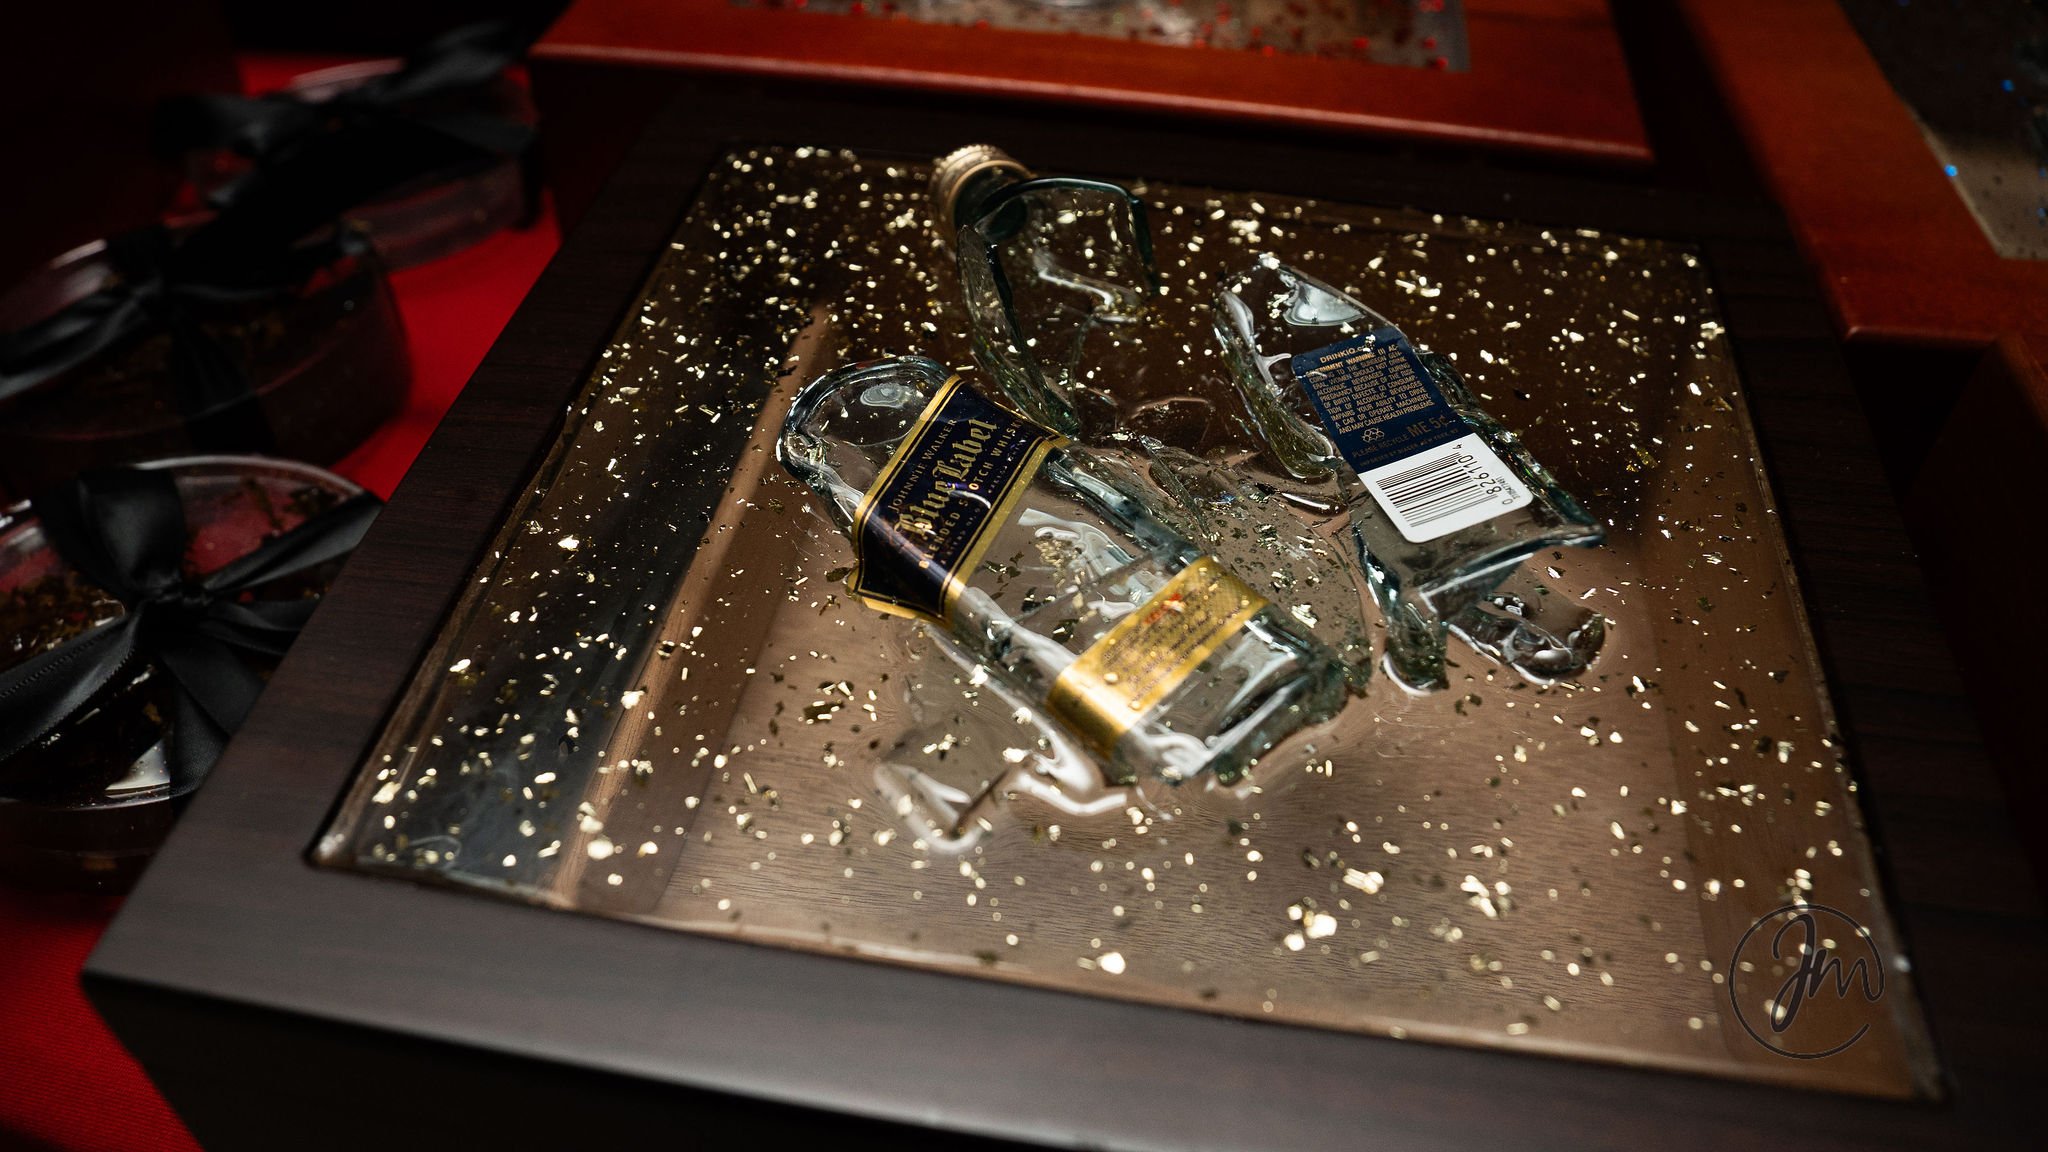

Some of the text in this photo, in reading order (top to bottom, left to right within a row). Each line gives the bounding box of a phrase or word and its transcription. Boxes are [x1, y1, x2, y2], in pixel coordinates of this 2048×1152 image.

[1305, 361, 1344, 377] GERNMENT
[1309, 372, 1335, 383] CORDNG
[1360, 356, 1387, 367] SURGEON
[1320, 343, 1371, 363] DRINKIQ.c
[1329, 374, 1351, 384] WOMEN
[1352, 366, 1375, 376] SHOULD
[1388, 356, 1406, 365] DRINK
[1316, 362, 1410, 396] ALCOHOLIC BEVERAGES DURING
[1320, 388, 1353, 402] PREGNANCY
[1354, 379, 1379, 391] BECAUSE
[1400, 368, 1414, 376] RISK
[1333, 396, 1350, 405] BIRTH
[1387, 374, 1418, 387] CONSUMP-
[1328, 406, 1342, 415] TION
[1355, 392, 1387, 406] ALCOHOLIC
[1389, 380, 1422, 394] BEVERAGES
[1331, 410, 1356, 422] IMPAIRS
[1357, 404, 1374, 413] YOUR
[1375, 396, 1397, 407] ABILITY
[1409, 386, 1426, 396] DRIVE
[1342, 417, 1356, 426] CAR
[1357, 413, 1367, 421] OR
[1368, 405, 1394, 417] OPERATE
[1395, 392, 1431, 408] MACHINERY,
[1338, 399, 1434, 435] AND MAY CAUSE HEALTH PROBLEMS.
[1407, 421, 1431, 437] ME
[888, 419, 958, 513] JOHNNIE WALKER
[894, 480, 956, 538] Blue
[932, 418, 997, 481] Label
[1458, 454, 1502, 494] 826110
[919, 512, 960, 569] BLENDED
[958, 462, 993, 507] SOTCH
